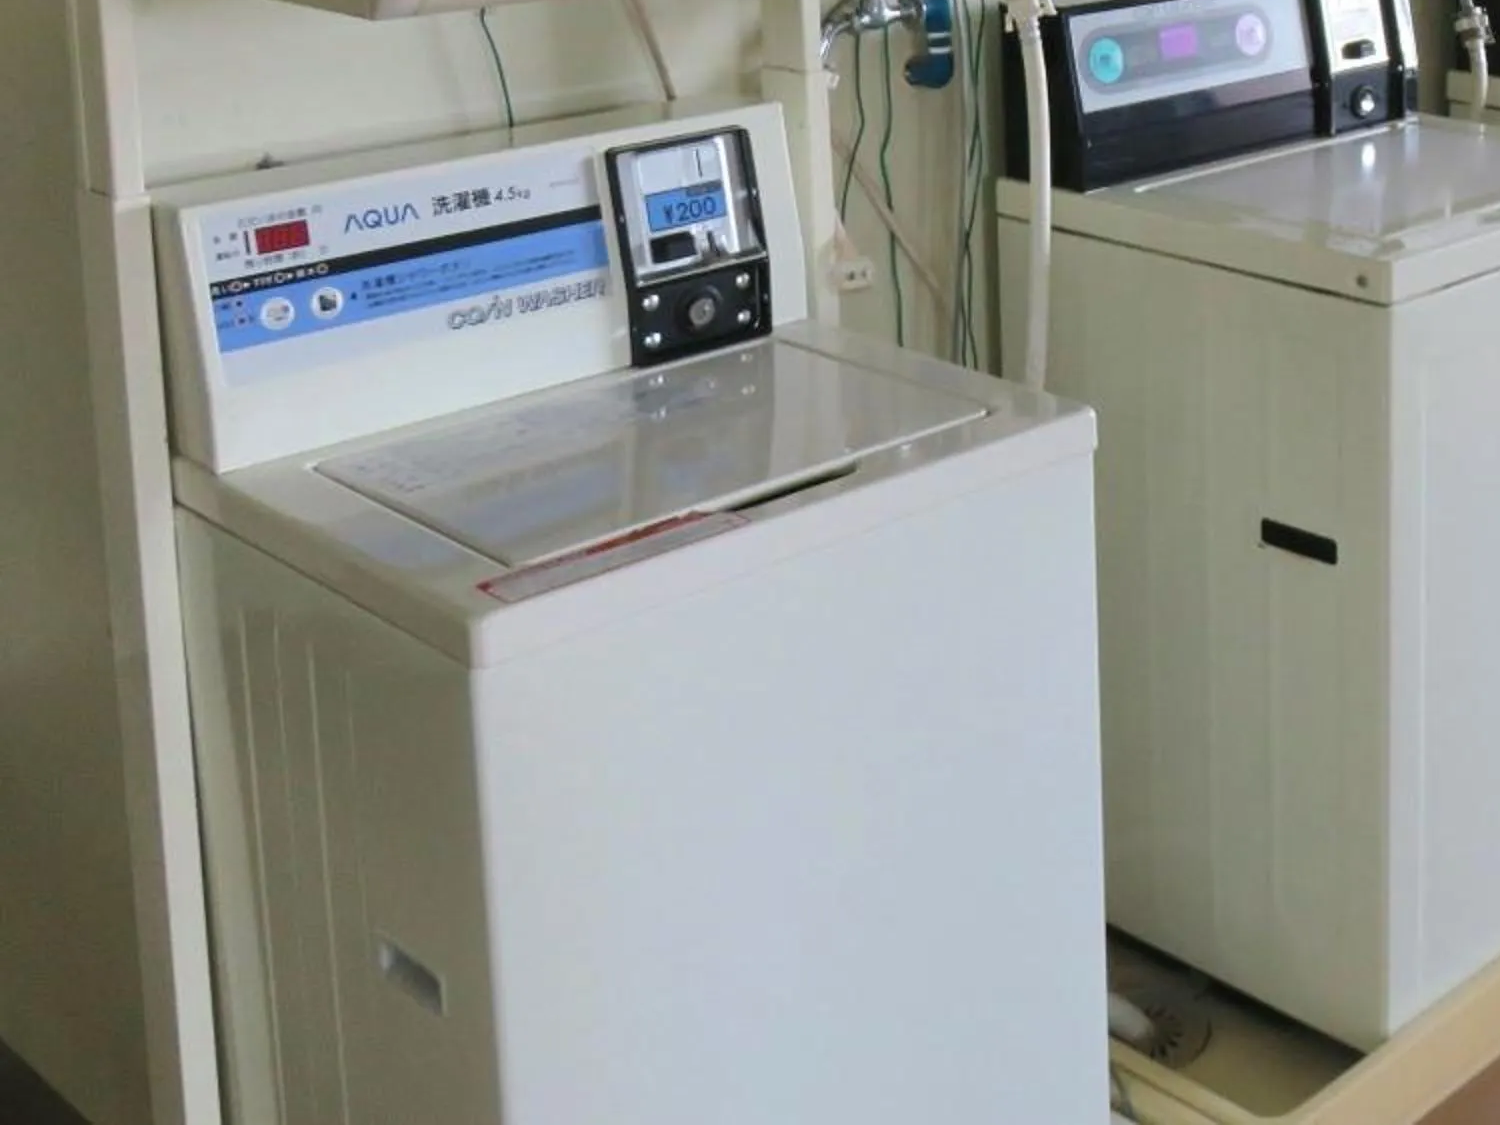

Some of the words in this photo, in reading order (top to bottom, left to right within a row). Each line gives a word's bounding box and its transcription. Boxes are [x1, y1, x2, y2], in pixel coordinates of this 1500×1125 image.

[344, 203, 420, 234] AQUA
[432, 187, 493, 217] 洗濯機
